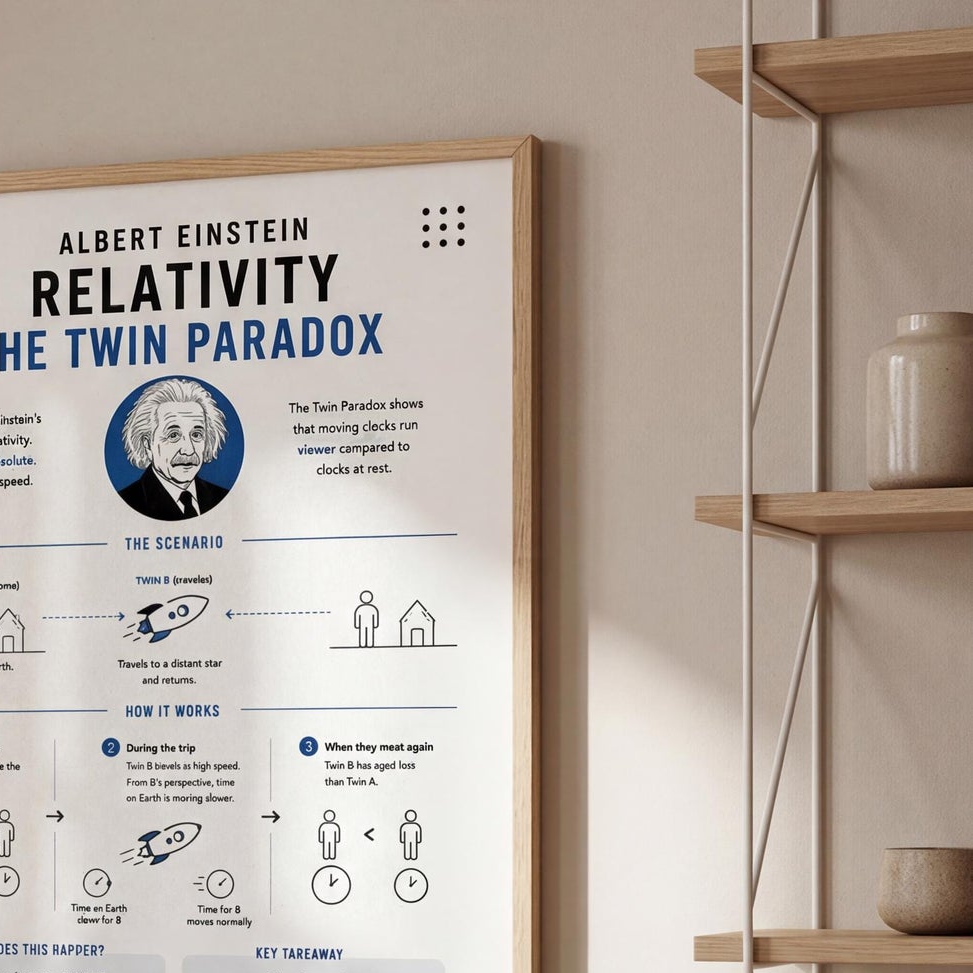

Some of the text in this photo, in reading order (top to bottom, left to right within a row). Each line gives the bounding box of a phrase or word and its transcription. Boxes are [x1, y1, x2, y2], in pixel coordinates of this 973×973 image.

[58, 218, 308, 254] ALBERT EINSTEIN
[32, 255, 338, 316] RELATIVITY
[64, 325, 166, 367] TWIN
[188, 314, 383, 361] PARADOX
[288, 398, 424, 413] The Twin Paradox shows
[292, 423, 315, 434] that
[318, 422, 359, 435] moving
[399, 422, 418, 430] run
[297, 444, 336, 455] viewer
[397, 441, 410, 451] to
[316, 463, 392, 475] clocks at rest.
[124, 536, 223, 550] THE SCENARIO
[135, 576, 161, 584] TWIN
[163, 576, 170, 584] B
[117, 659, 148, 668] Travels
[170, 658, 202, 668] distant
[142, 675, 159, 684] and
[125, 704, 219, 717] HOW IT WORKS
[126, 743, 158, 754] During
[160, 743, 176, 752] the
[178, 743, 196, 754] trip
[324, 742, 353, 751] When
[355, 742, 377, 754] they
[406, 742, 434, 753] again
[6, 761, 20, 770] the
[126, 761, 144, 770] Twin
[146, 761, 153, 770] B
[192, 761, 211, 772] high
[213, 761, 240, 772] speed.
[324, 760, 345, 769] Twin
[347, 760, 354, 769] B
[356, 760, 372, 769] has
[373, 760, 396, 772] aged
[126, 778, 235, 788] From B's perspective, time
[324, 776, 378, 786] than Twin A.
[138, 793, 162, 802] Earth
[163, 793, 170, 802] is
[205, 792, 234, 802] slower.
[70, 903, 91, 912] Time
[105, 904, 128, 912] Earth
[197, 904, 218, 913] Time
[219, 904, 232, 913] for
[216, 917, 252, 928] normally
[22, 943, 48, 955] THIS
[256, 947, 278, 959] KEY
